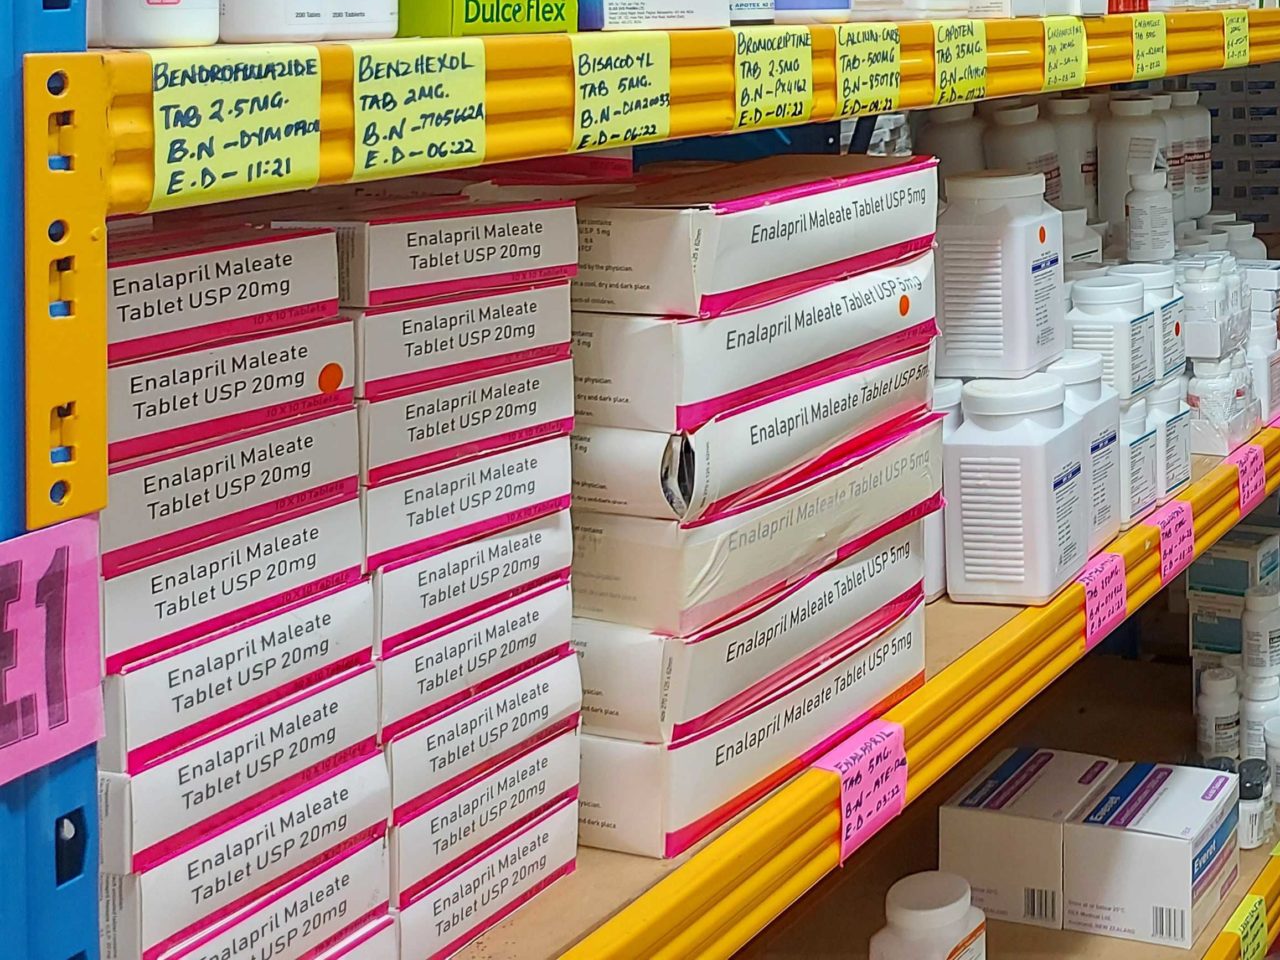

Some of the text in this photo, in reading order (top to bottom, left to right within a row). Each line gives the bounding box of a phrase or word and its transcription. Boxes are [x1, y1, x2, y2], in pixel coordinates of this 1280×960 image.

[738, 32, 811, 55] BROMOCRIPTINE
[938, 22, 973, 43] CAPOTEN
[579, 52, 654, 76] BISACODYL
[740, 61, 762, 79] TAB
[360, 92, 397, 112] TAB
[580, 80, 609, 100] TAB
[160, 104, 202, 130] TAB
[247, 157, 291, 182] 11:21
[406, 222, 542, 248] Enalapril Maleate
[751, 187, 926, 244] Enalapril Maleate Tablet USP 5mg
[112, 255, 292, 298] Enalapril Maleate
[409, 244, 540, 270] Tablet USP 20mg
[116, 280, 289, 322] Tablet USP 20mg
[726, 276, 923, 350] Enalapril Maleate Tablet USP 5mg
[131, 346, 307, 394] Enalapril Maleate
[133, 371, 304, 419] Tablet USP 20mg
[406, 379, 539, 420] Enalapril Maleate
[407, 401, 536, 442] Tablet USP 20mg
[152, 528, 318, 594] Enalapril Maleate
[154, 553, 316, 619] Tablet USP 20mg
[415, 611, 539, 673] Enalapril Maleate
[417, 633, 536, 694] Tablet USP 20mg
[716, 632, 911, 766] Enalapril Maleate Tablet USP 5mg
